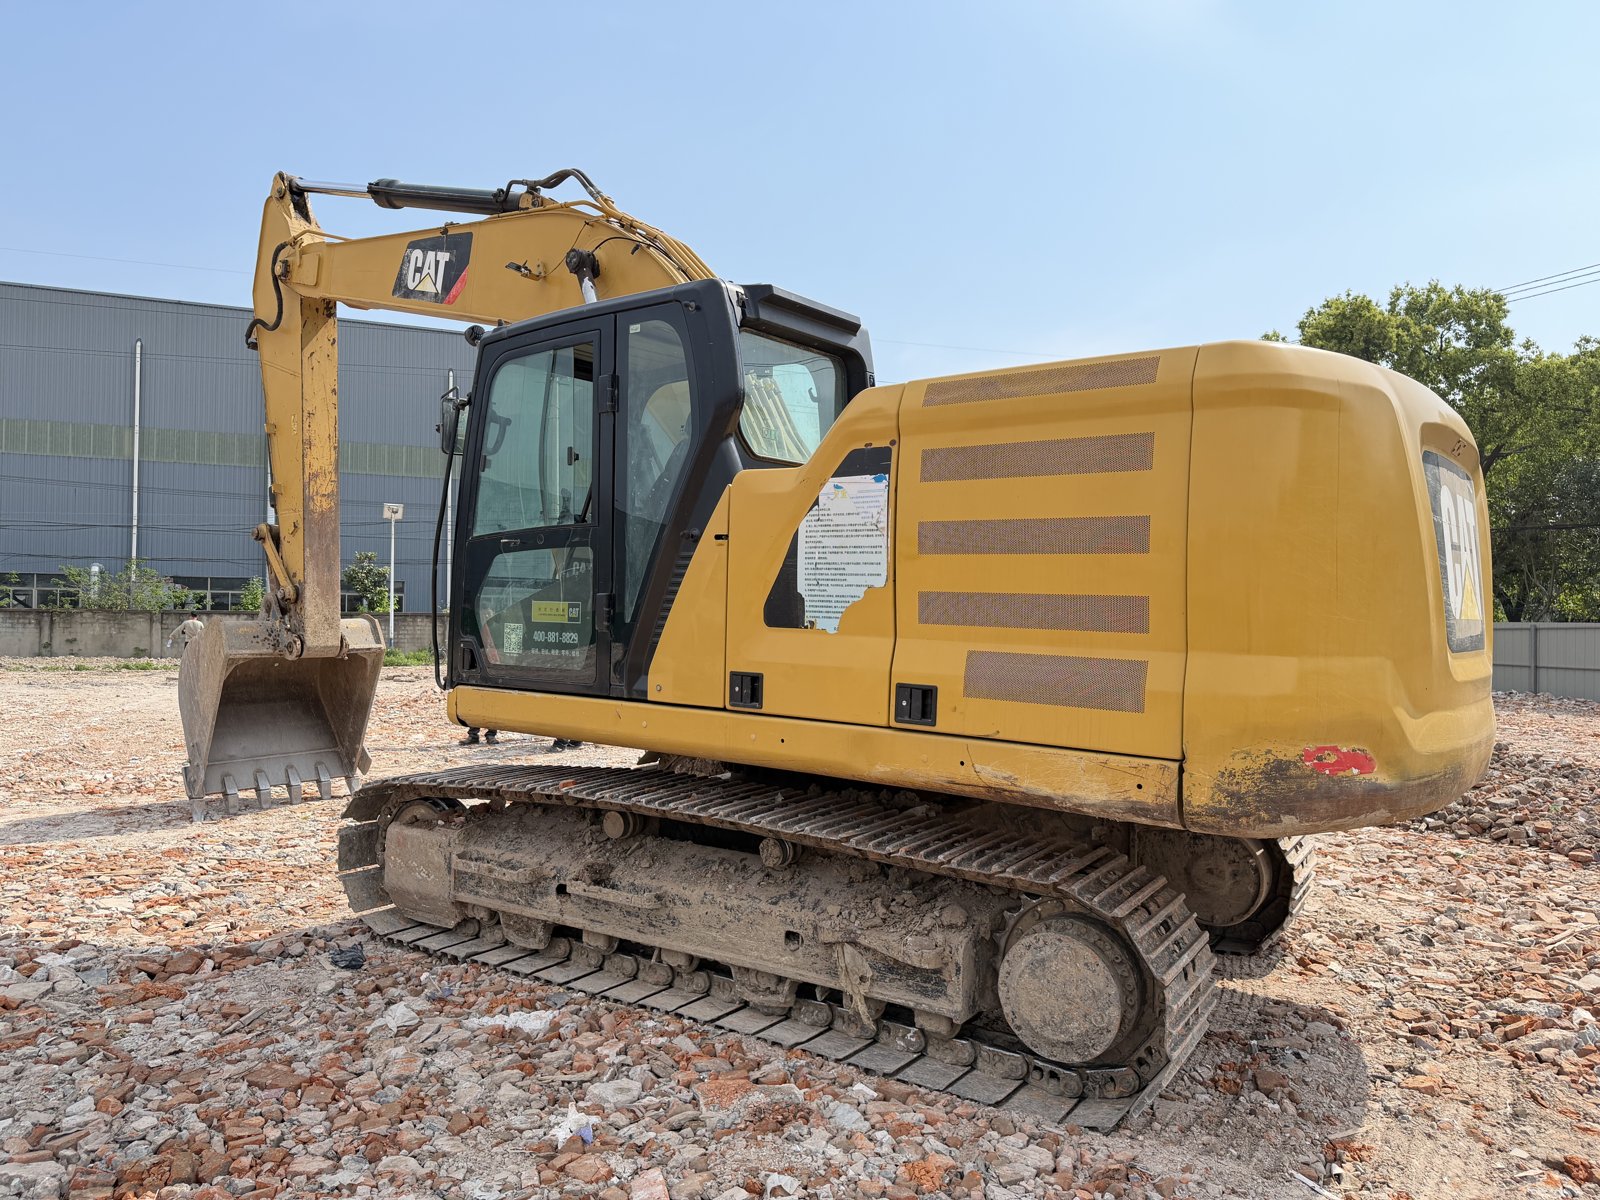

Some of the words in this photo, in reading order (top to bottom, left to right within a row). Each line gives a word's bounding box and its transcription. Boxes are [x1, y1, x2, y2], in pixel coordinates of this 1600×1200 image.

[407, 248, 450, 294] CAT
[1440, 485, 1482, 620] CAT
[569, 607, 579, 617] CAT
[533, 631, 579, 644] 400-881-8829
